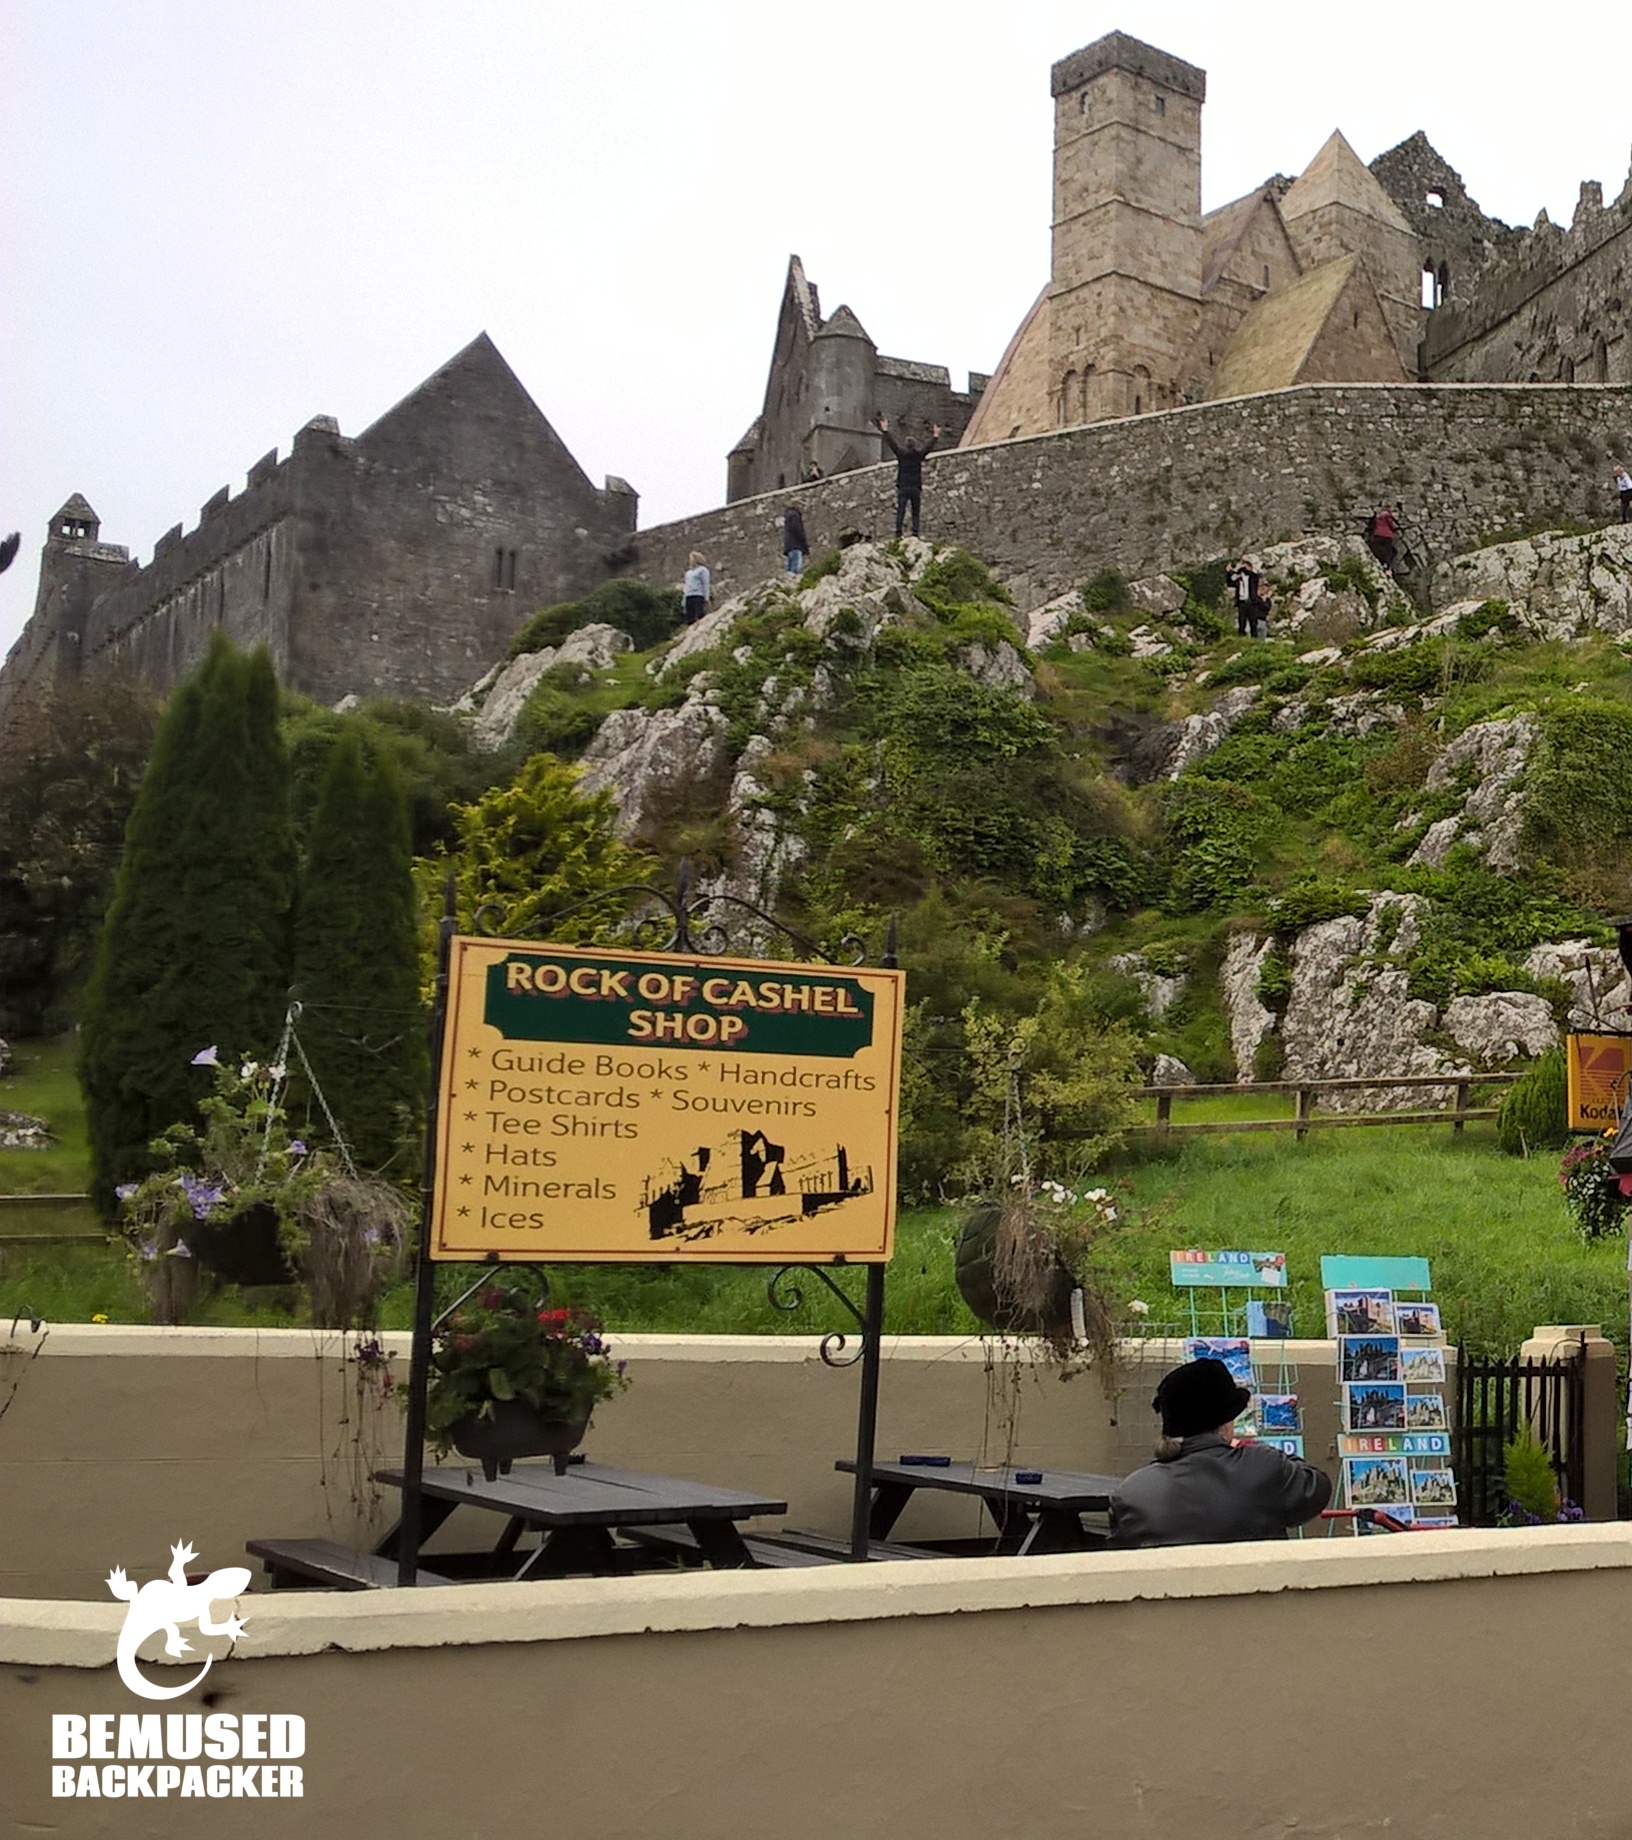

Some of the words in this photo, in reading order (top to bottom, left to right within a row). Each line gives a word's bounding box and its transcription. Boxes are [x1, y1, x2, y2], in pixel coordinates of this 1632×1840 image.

[506, 962, 629, 997] ROCK
[639, 973, 696, 1002] OF
[702, 978, 860, 1014] CASHEL
[628, 1009, 745, 1042] SHOP
[491, 1048, 585, 1076] Guide
[596, 1055, 688, 1081] Books
[720, 1062, 876, 1092] Handcrafts
[489, 1080, 640, 1109] Postcards
[672, 1090, 817, 1117] Souvenirs
[486, 1111, 541, 1135] Tee
[551, 1114, 638, 1139] Shirts
[486, 1144, 557, 1167] Hats
[484, 1174, 616, 1200] Minerals
[481, 1207, 544, 1230] Ices
[1176, 1252, 1249, 1263] IRELAND
[1347, 1436, 1443, 1451] IRELAND
